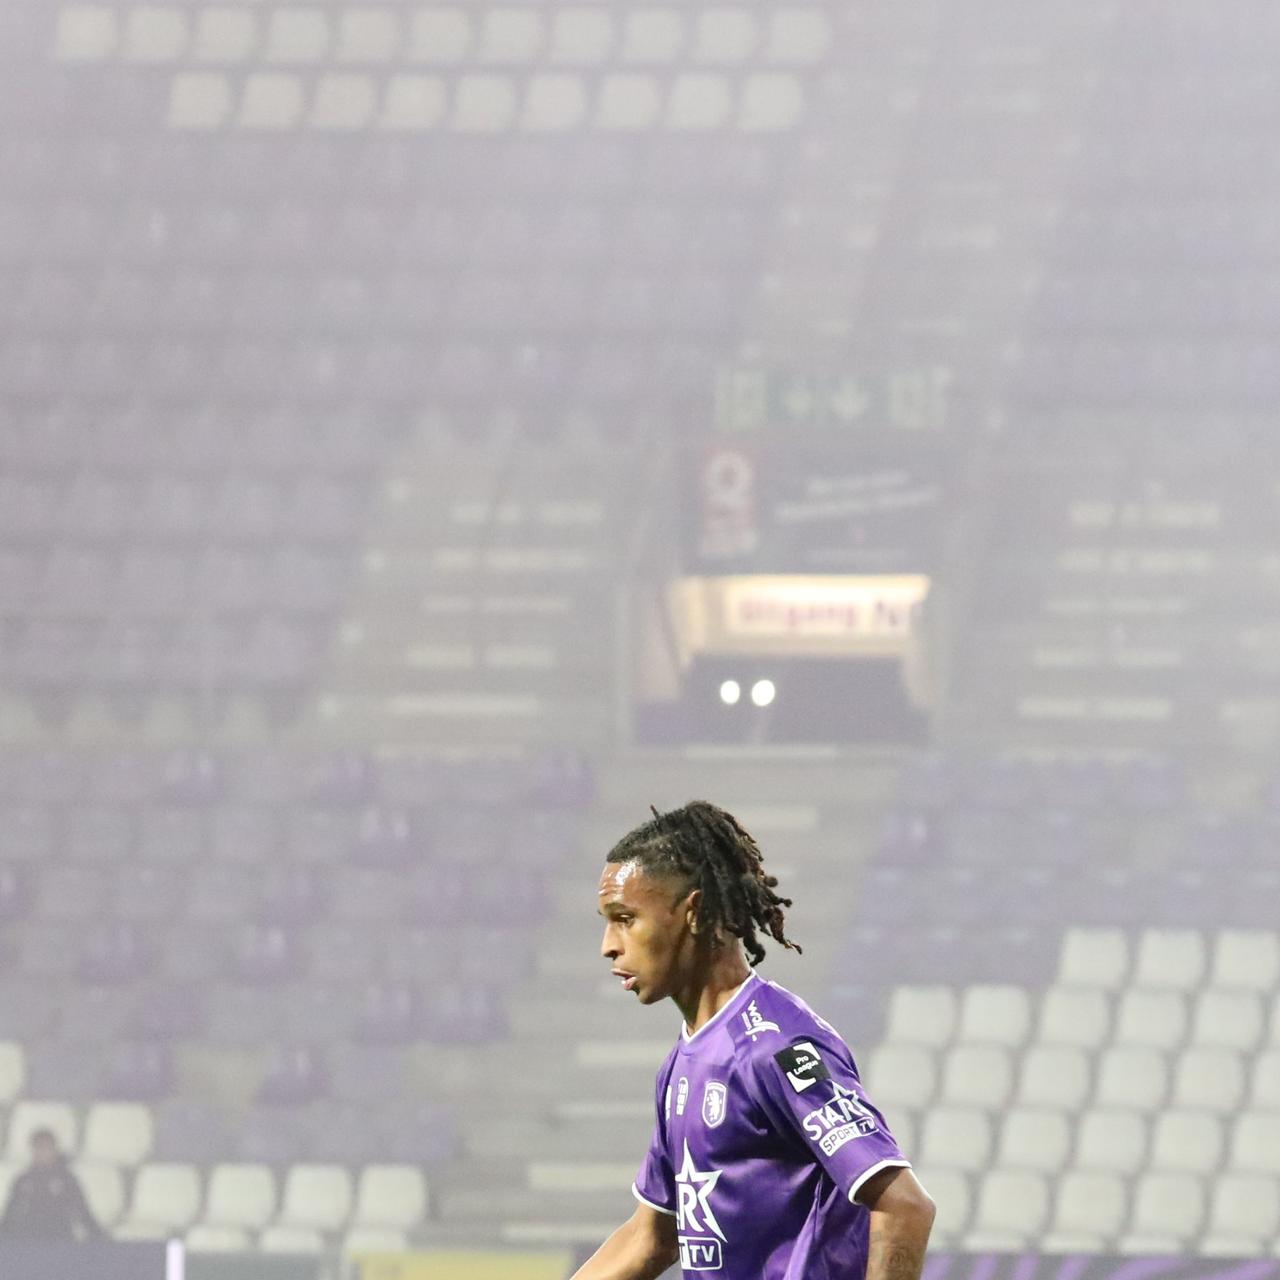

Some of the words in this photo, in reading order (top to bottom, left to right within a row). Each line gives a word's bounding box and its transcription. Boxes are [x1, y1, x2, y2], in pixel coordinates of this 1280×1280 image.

[793, 1060, 819, 1076] League
[796, 1056, 809, 1065] Pro
[803, 1096, 870, 1141] STAR
[822, 1124, 858, 1152] SPORT
[689, 1245, 716, 1264] TV
